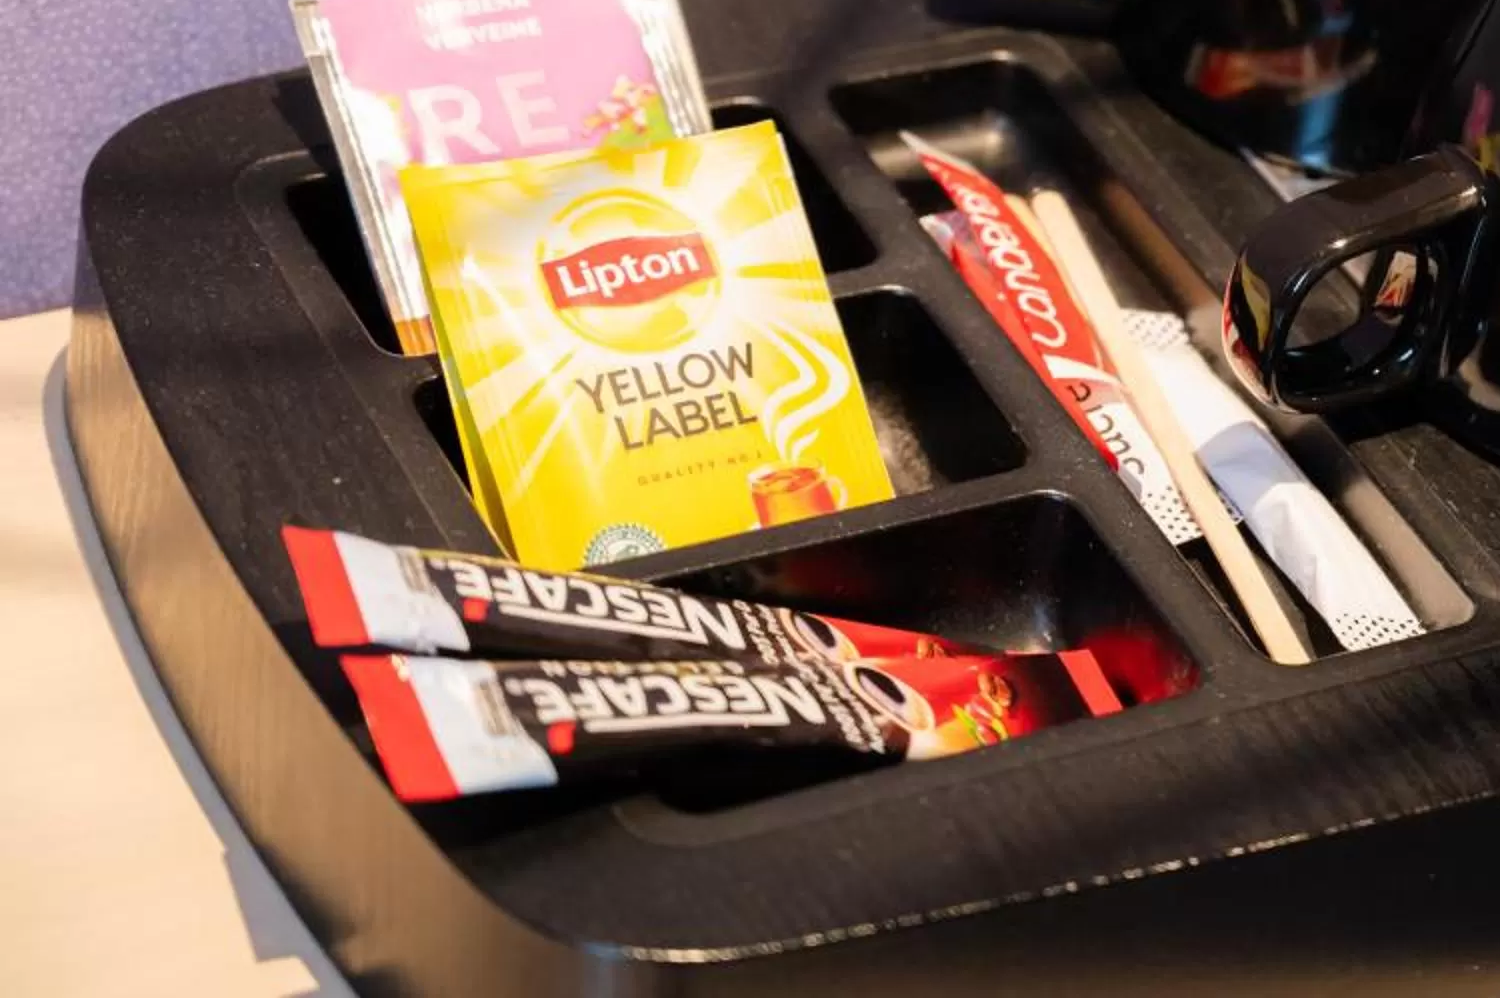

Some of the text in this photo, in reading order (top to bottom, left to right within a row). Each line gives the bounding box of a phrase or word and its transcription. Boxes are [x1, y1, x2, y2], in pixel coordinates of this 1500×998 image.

[556, 245, 701, 299] Lipton
[575, 341, 755, 415] YELLOW
[614, 390, 759, 451] LABEL
